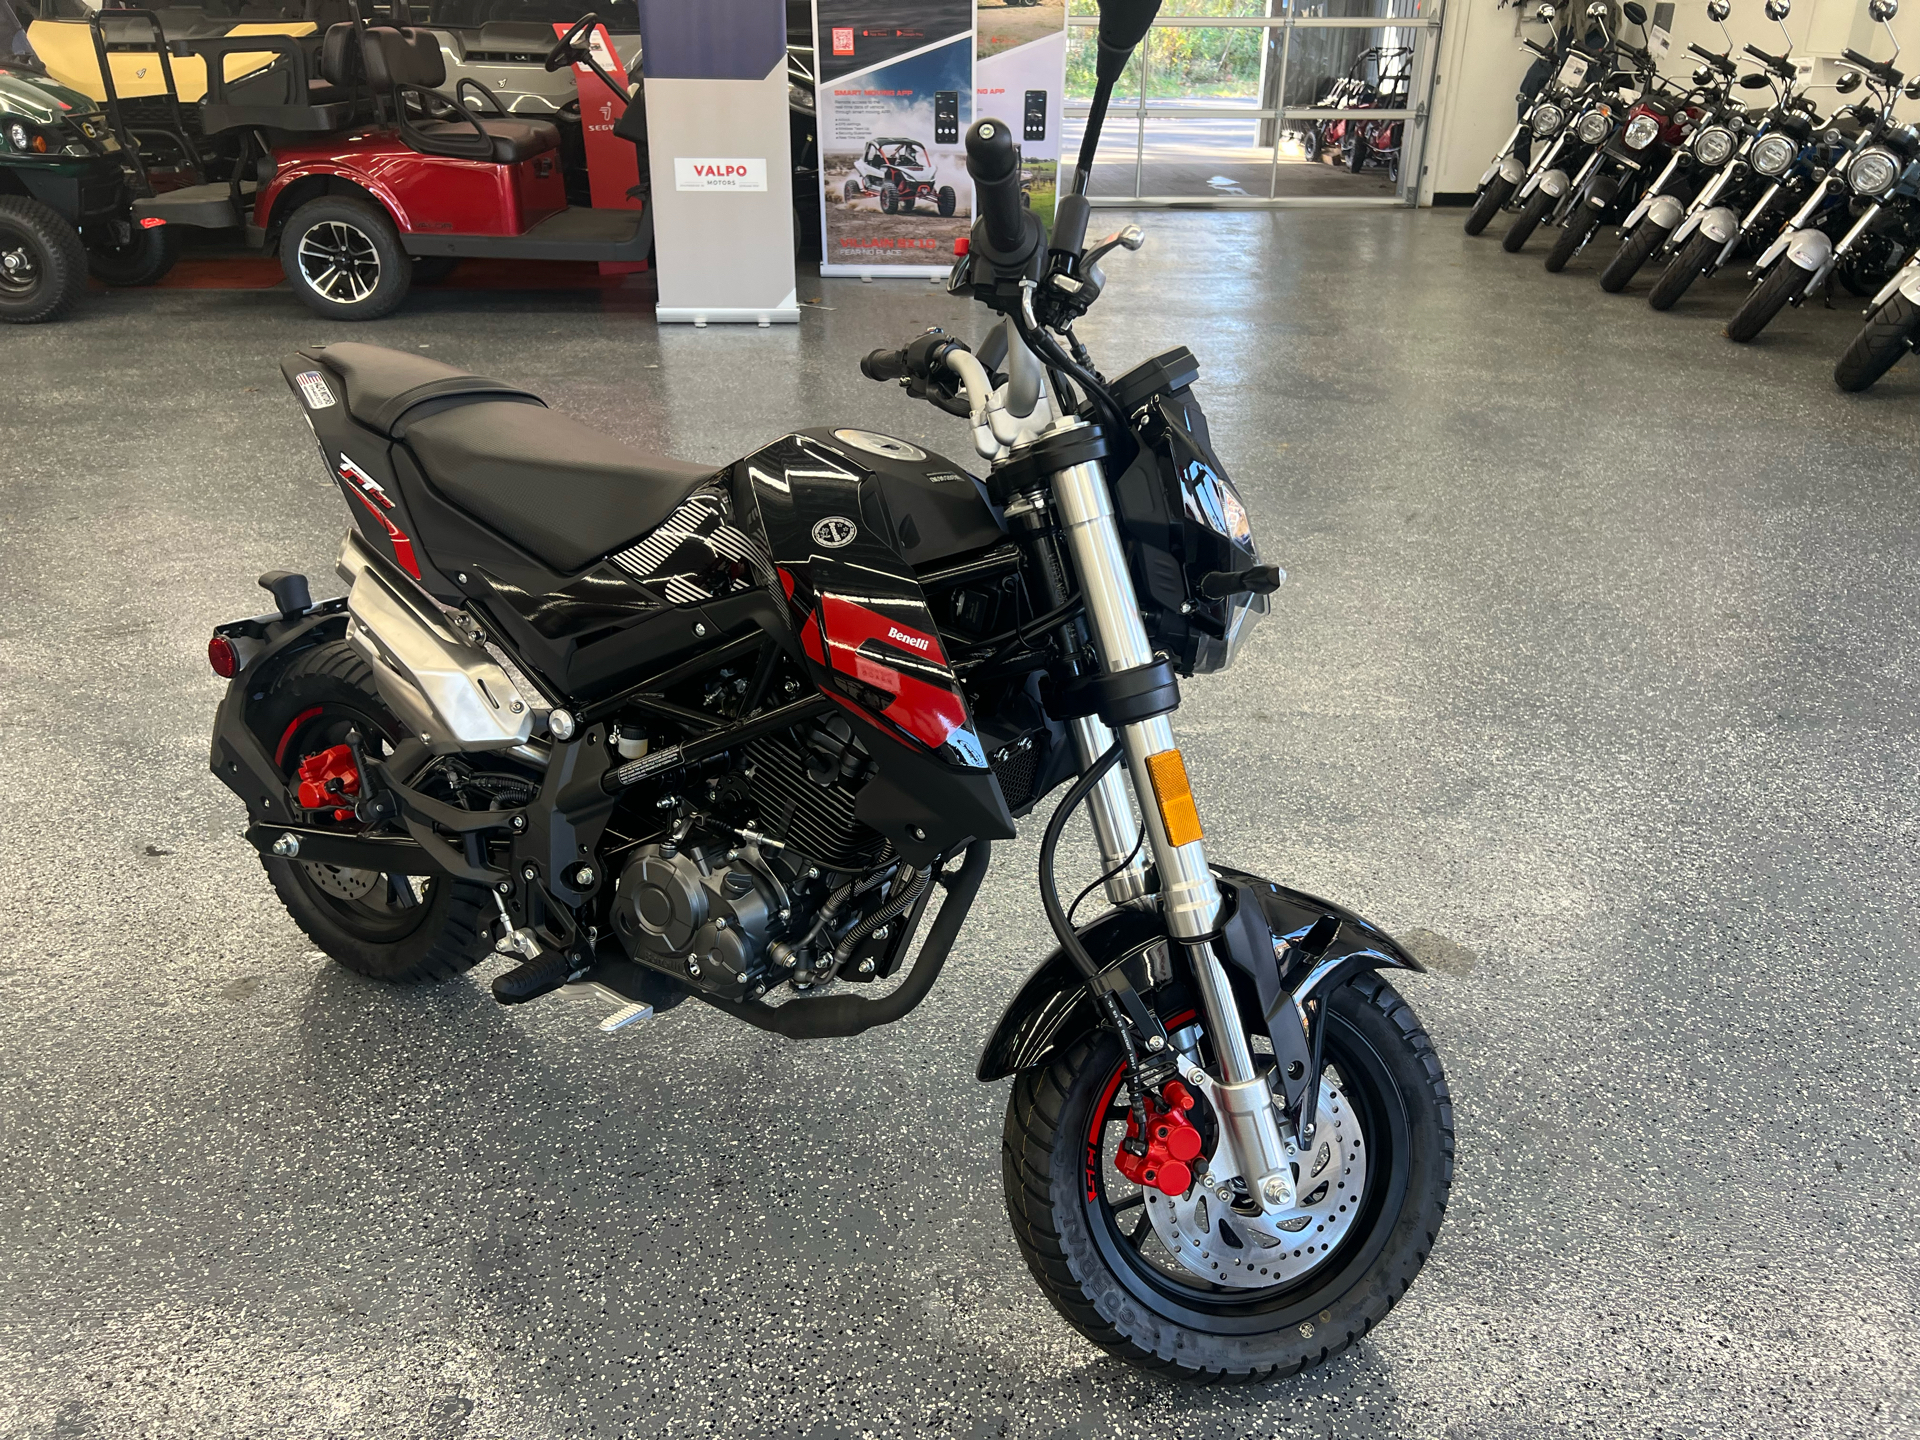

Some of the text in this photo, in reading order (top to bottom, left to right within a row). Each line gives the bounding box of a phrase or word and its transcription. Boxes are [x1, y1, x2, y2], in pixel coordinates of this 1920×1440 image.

[693, 165, 747, 177] VALPO
[840, 238, 894, 248] VILLAIN
[888, 626, 929, 651] Benelli
